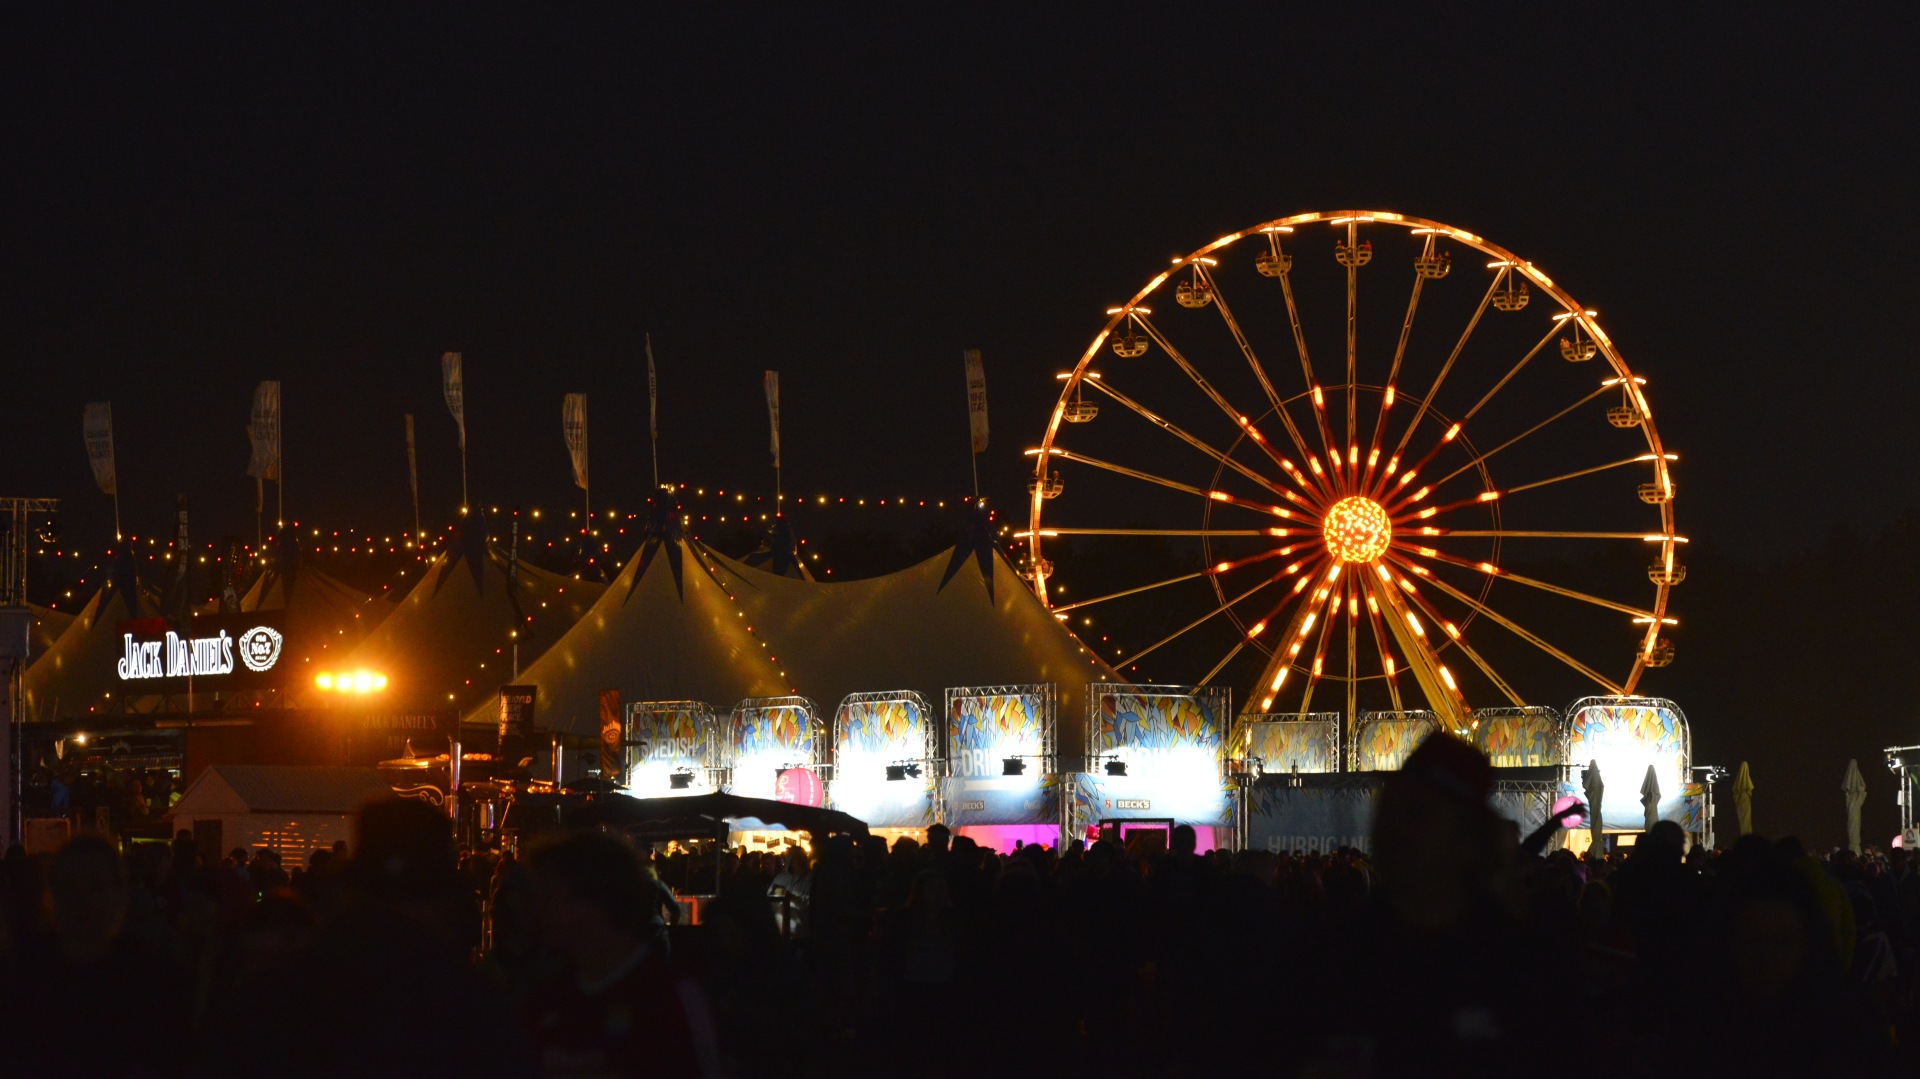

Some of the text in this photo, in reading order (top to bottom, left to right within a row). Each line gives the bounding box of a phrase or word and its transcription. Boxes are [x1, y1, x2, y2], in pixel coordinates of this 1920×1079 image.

[117, 629, 234, 680] JACK DANIEL'S
[641, 736, 696, 758] SWEDISH
[1118, 800, 1150, 809] BECK'S
